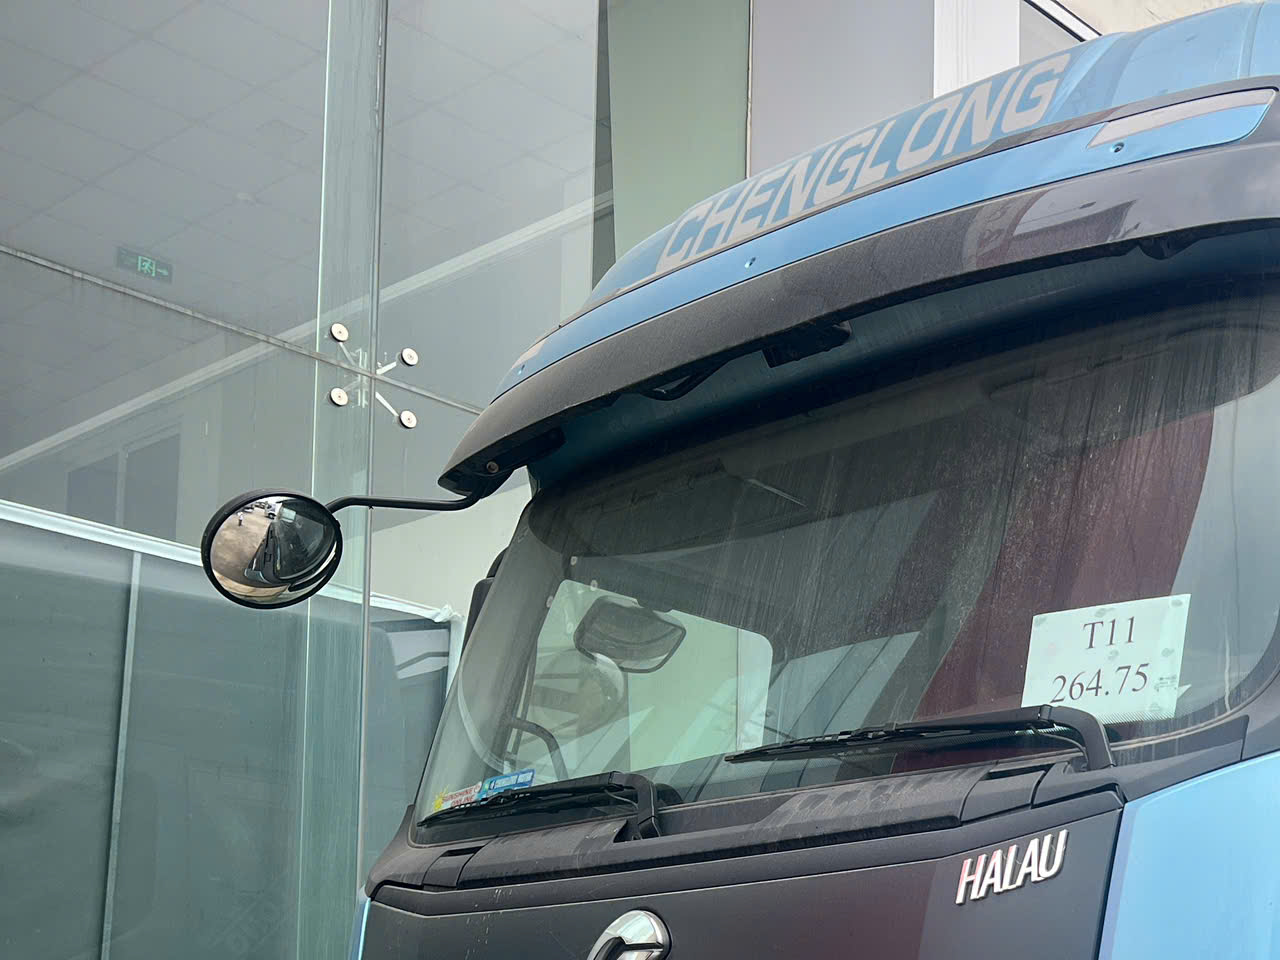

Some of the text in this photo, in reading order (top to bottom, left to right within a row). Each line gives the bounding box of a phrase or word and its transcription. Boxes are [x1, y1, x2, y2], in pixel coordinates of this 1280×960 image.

[655, 52, 1071, 274] CHENGLONG
[1083, 616, 1135, 650] T11
[1050, 663, 1149, 704] 264.75
